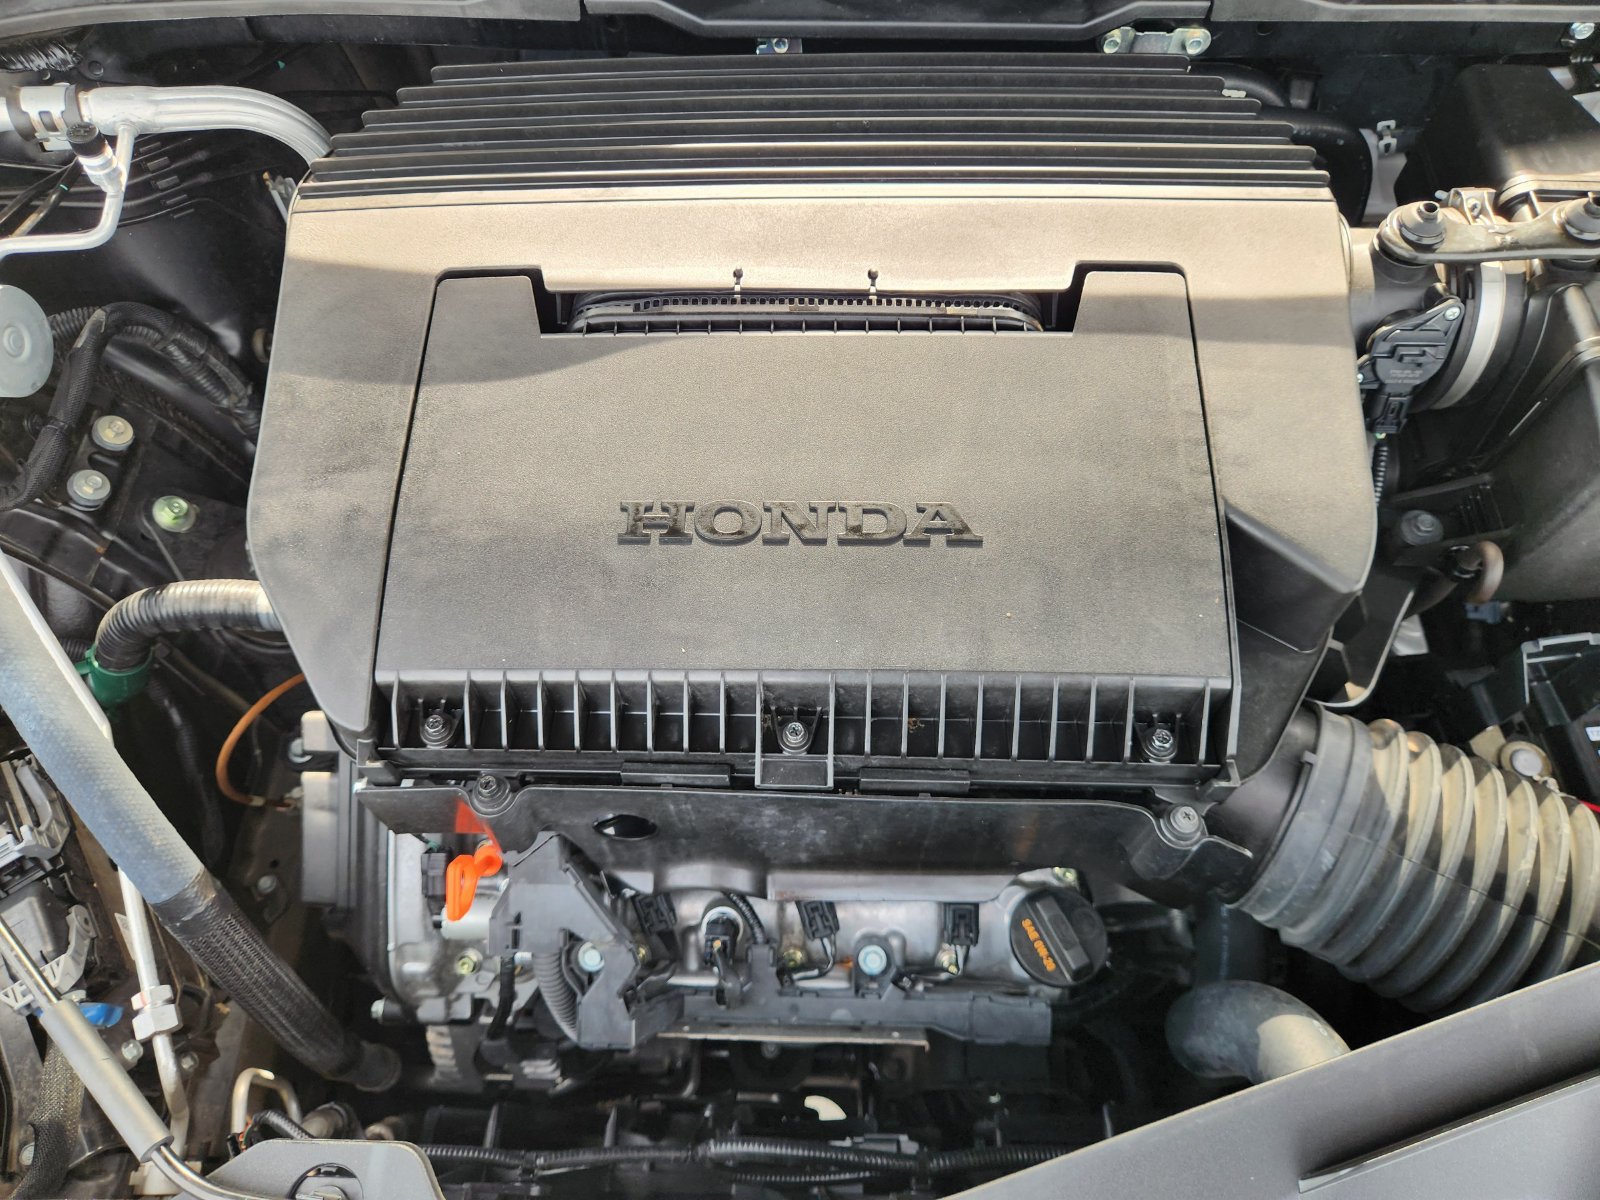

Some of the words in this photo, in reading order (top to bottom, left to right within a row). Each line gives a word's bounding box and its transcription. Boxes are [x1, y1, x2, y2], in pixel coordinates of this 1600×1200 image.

[617, 501, 984, 547] HONDA
[1021, 918, 1040, 942] SAE
[1034, 939, 1056, 972] 0W-20
